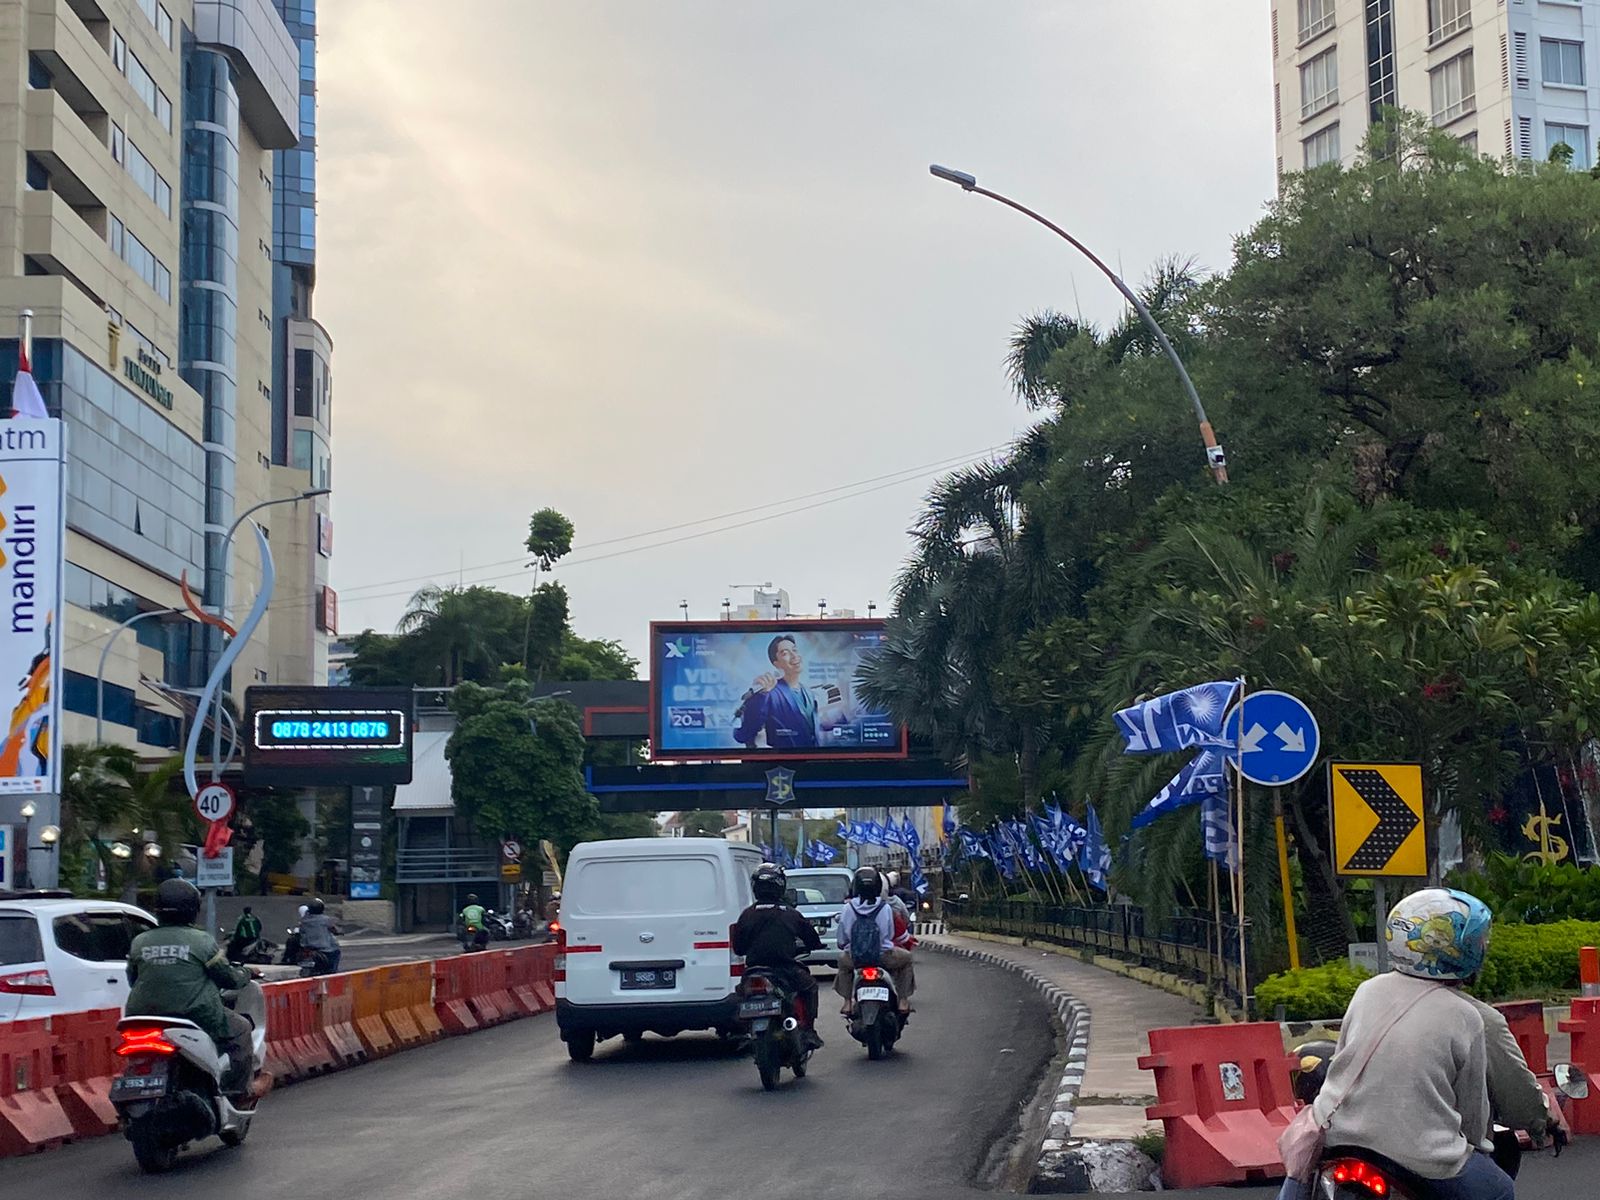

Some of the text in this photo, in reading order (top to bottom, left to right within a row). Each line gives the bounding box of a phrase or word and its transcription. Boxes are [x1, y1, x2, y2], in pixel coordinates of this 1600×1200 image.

[6, 505, 35, 633] mandiri
[272, 722, 388, 738] 0878 2413 0876
[200, 795, 220, 814] 40
[142, 945, 190, 960] GREEN
